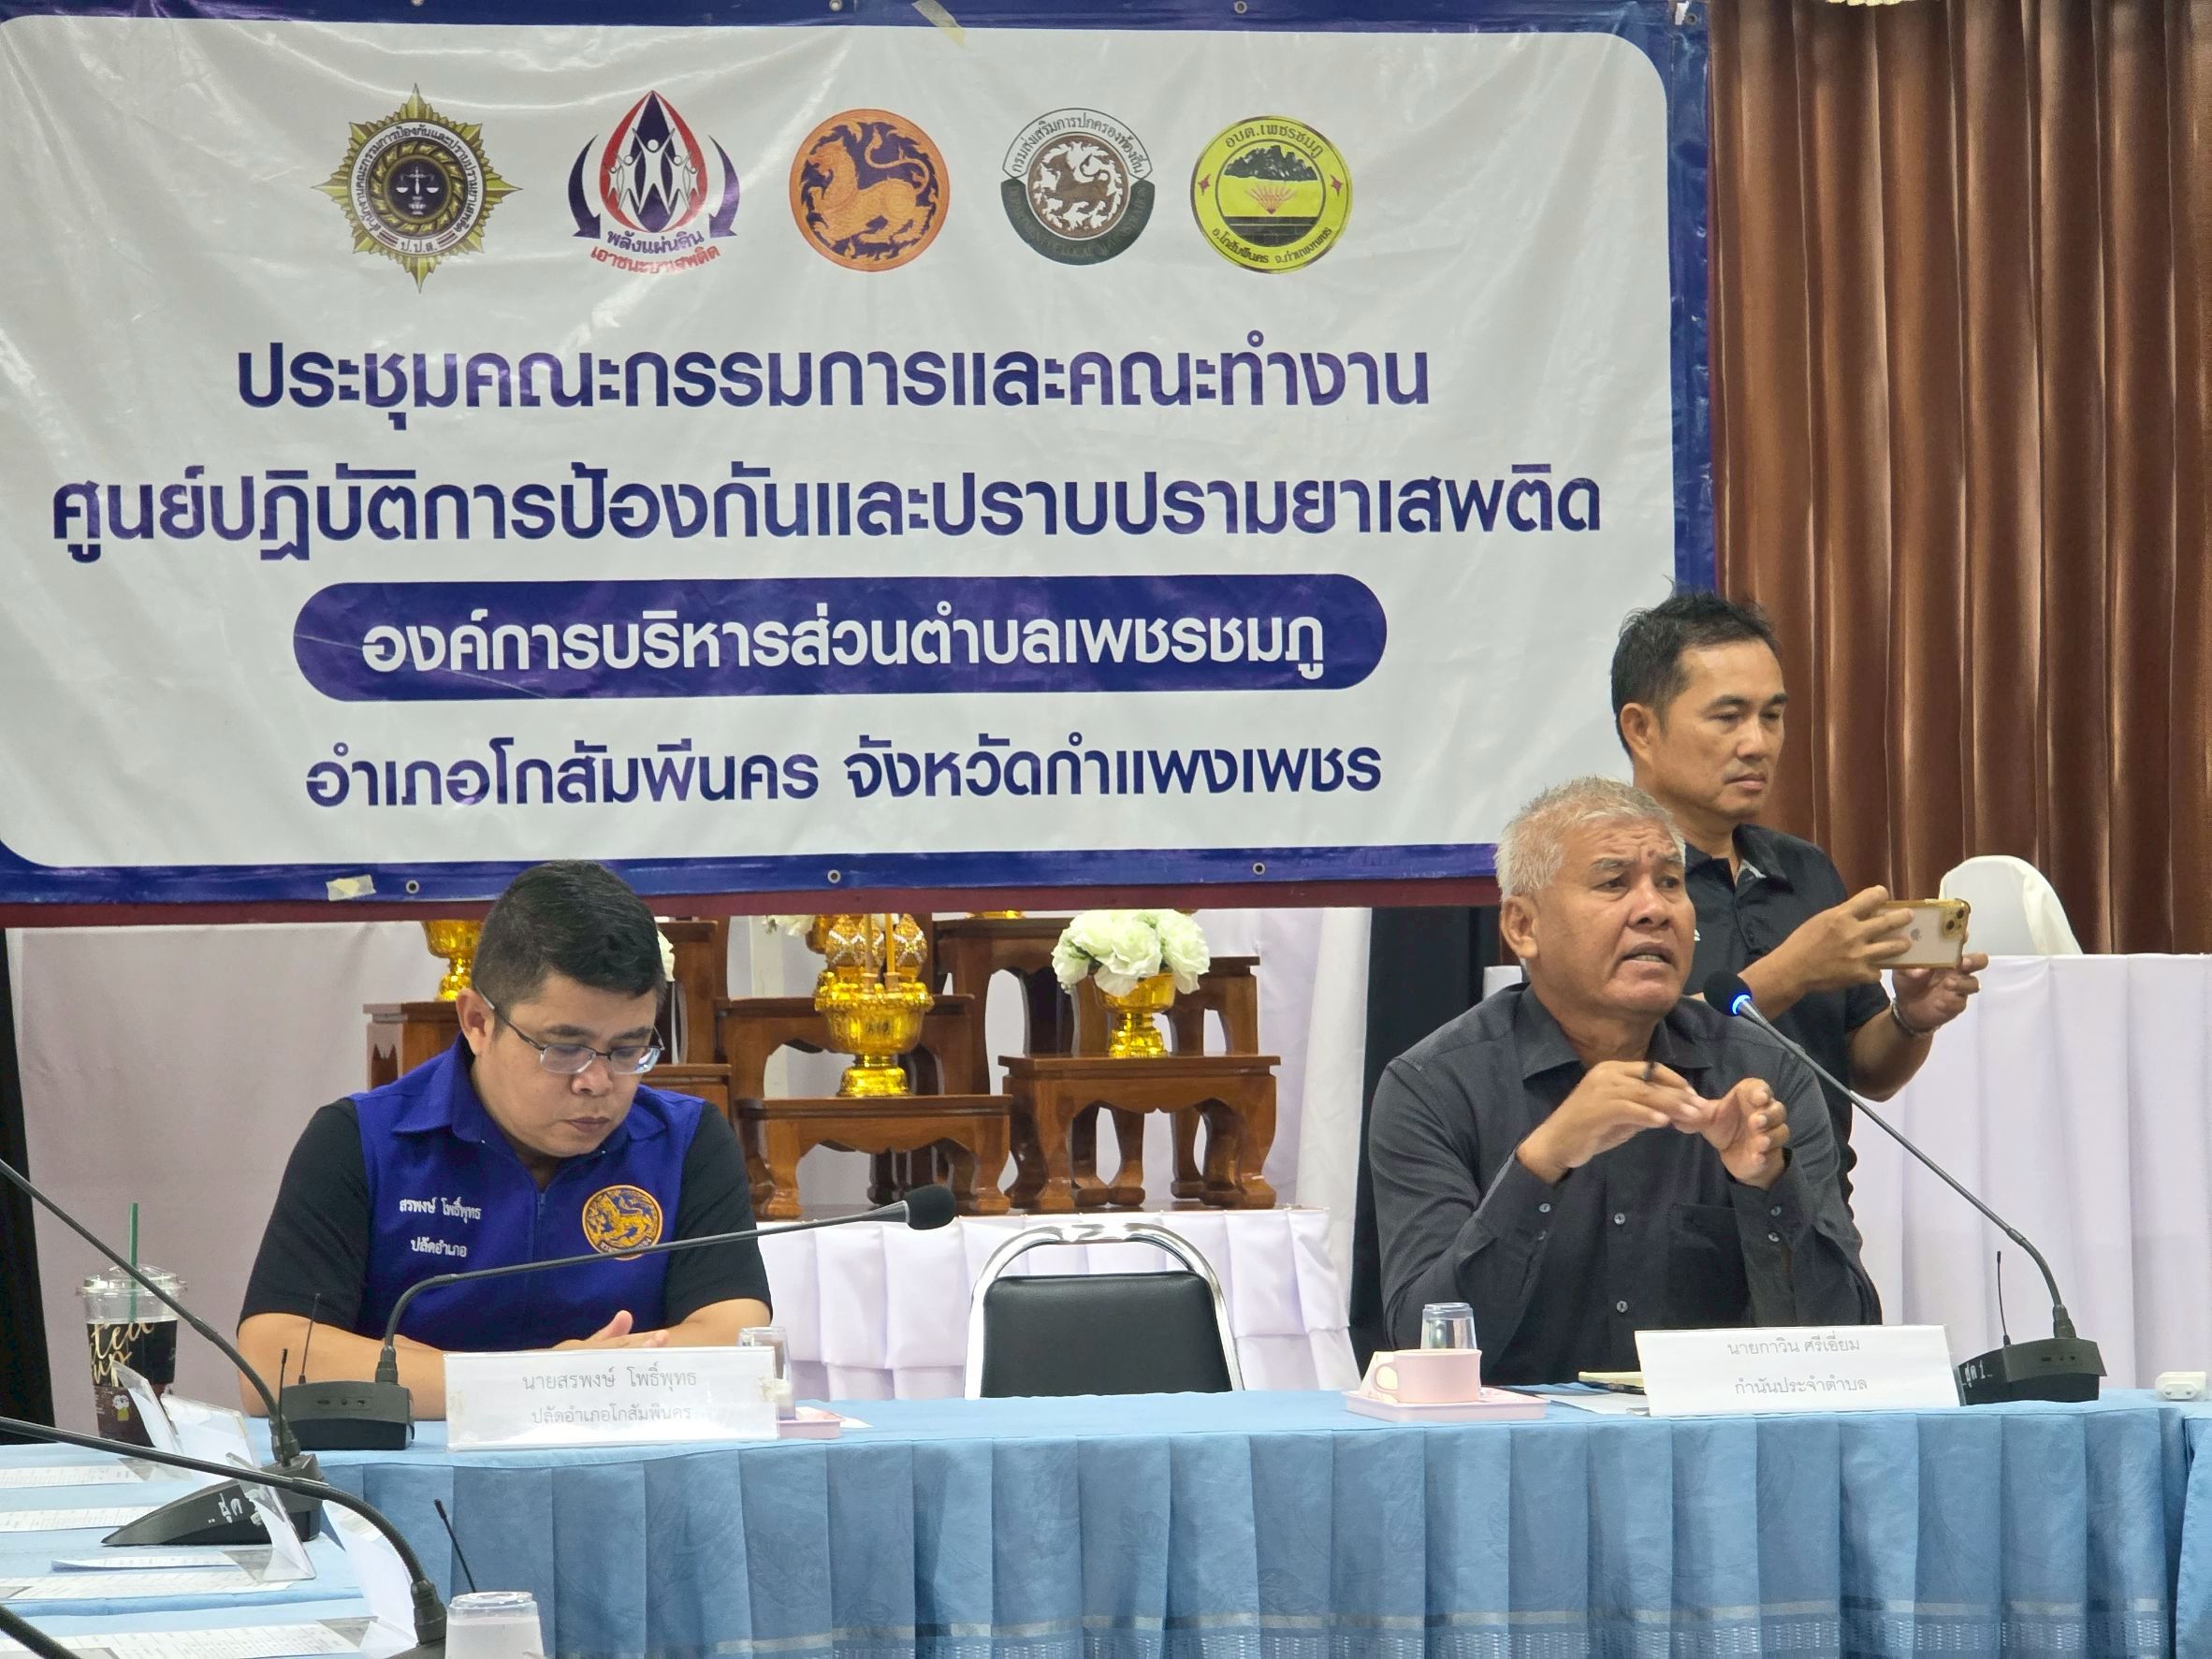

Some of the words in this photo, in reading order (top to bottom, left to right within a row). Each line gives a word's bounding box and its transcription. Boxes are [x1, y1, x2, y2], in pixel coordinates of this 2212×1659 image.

[1224, 124, 1324, 159] อบต.เพชรชมภู
[606, 229, 705, 255] พลังแผ่นดิน
[238, 329, 1429, 431] ประชุมคณะกรรมการและคณะทำงาน
[52, 460, 1601, 563] ศูนย์ปฏิบัติการป้องกันและปราบปรามยาเสพติด
[361, 600, 1325, 681] องค์การบริหารส่วนตำบลเพชรชมภู
[306, 736, 819, 808] อำเภอโกสัมพีนคร
[843, 731, 1382, 798] จังหวัดกำแพงเพชร
[410, 1236, 467, 1258] ปลัดอำเภอ
[522, 1365, 616, 1390] นายสรพงษ์
[626, 1361, 697, 1392] โพธิ์พุทธ
[1735, 1374, 1869, 1395] กำนันประจำตำบล
